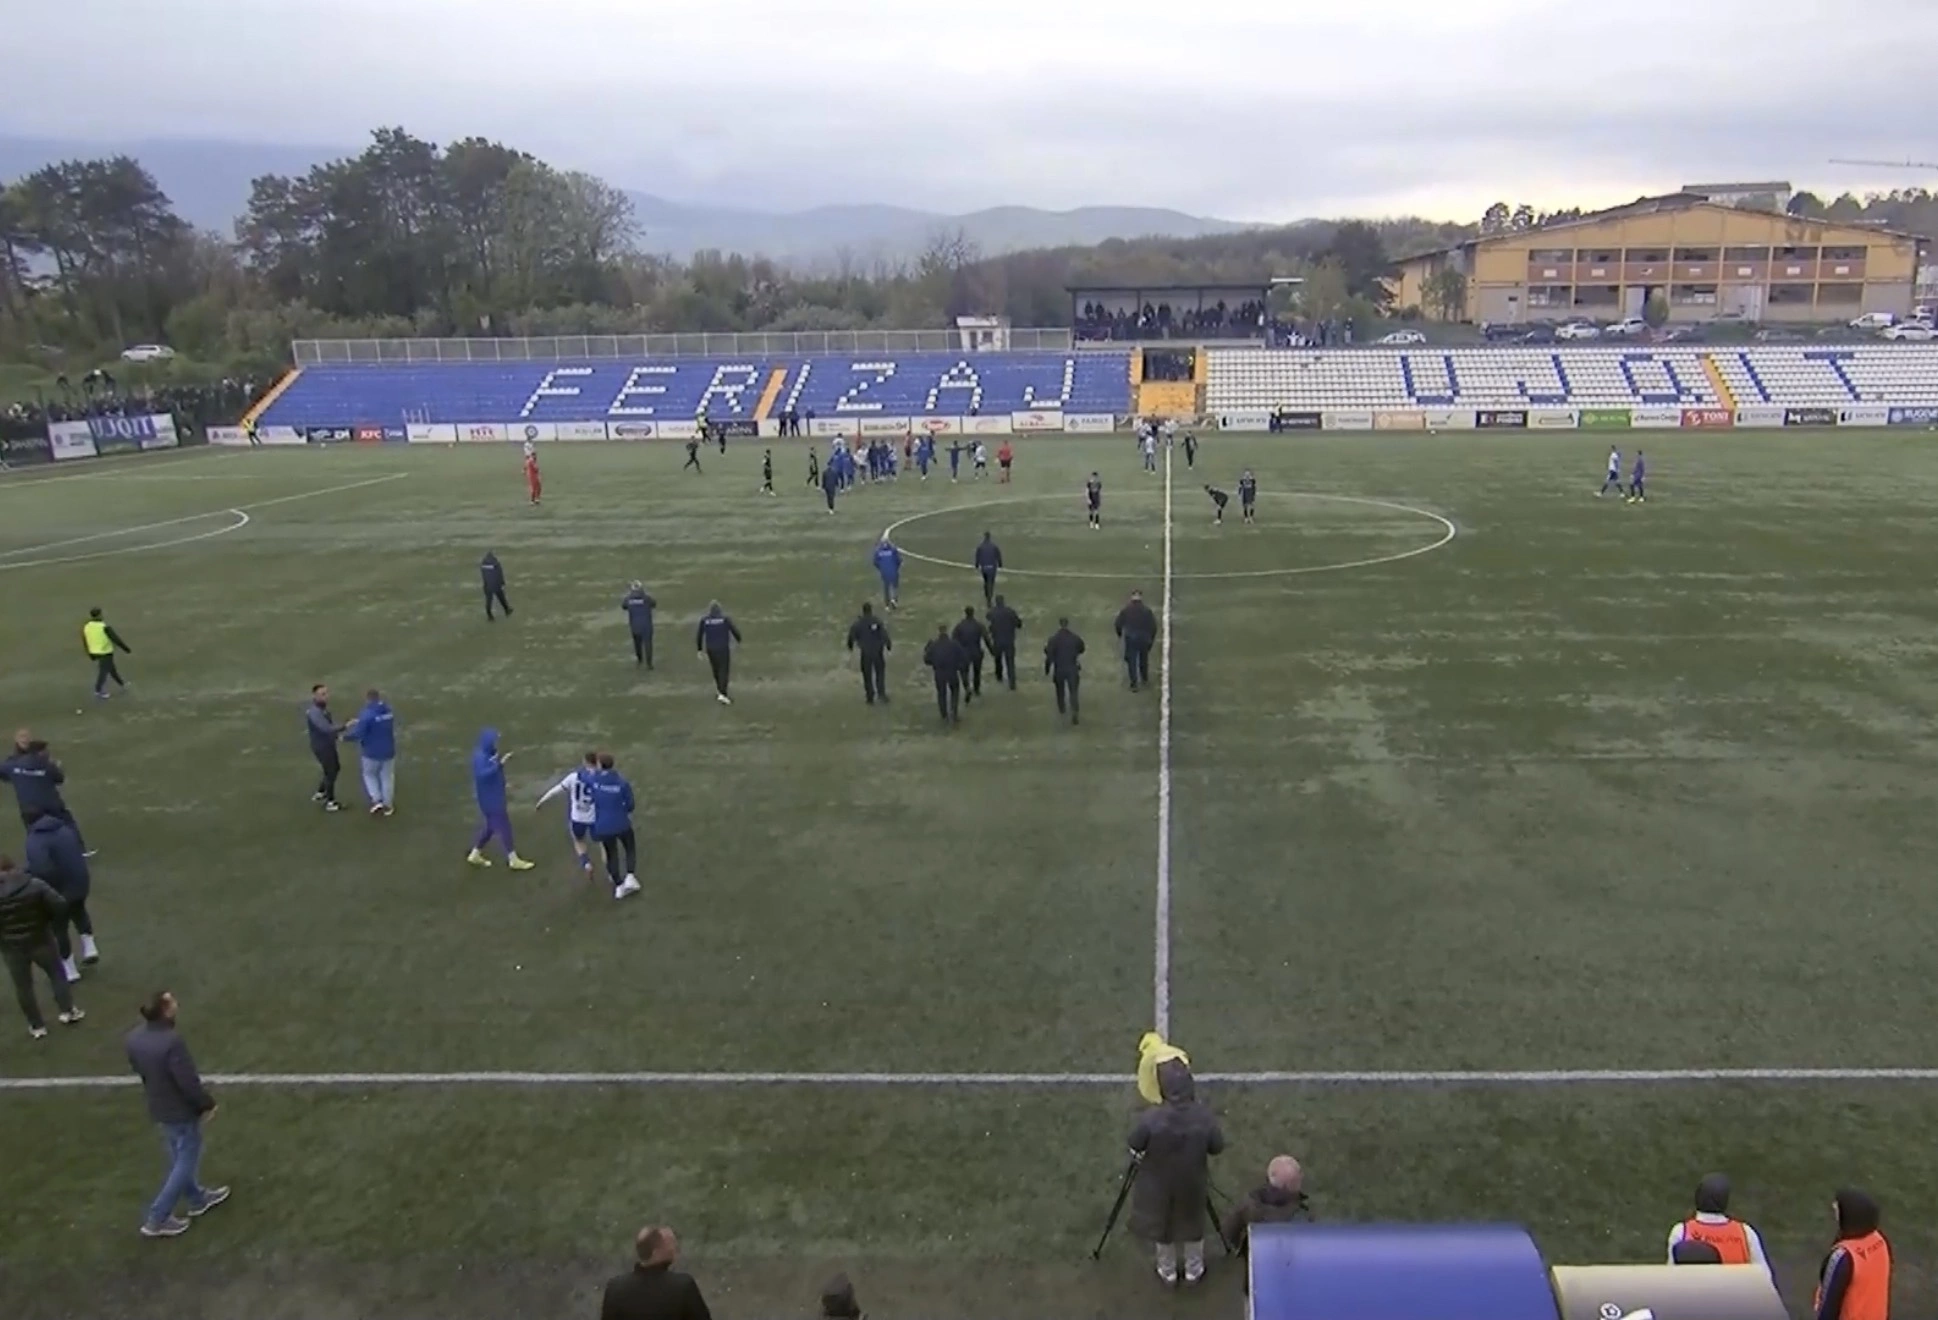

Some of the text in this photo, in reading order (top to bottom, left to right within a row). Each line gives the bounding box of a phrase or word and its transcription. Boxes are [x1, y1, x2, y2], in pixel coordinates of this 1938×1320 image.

[520, 359, 1075, 418] FERIZAJ
[1702, 411, 1729, 421] TONI
[90, 416, 152, 439] UJQIT
[360, 429, 382, 440] KFC
